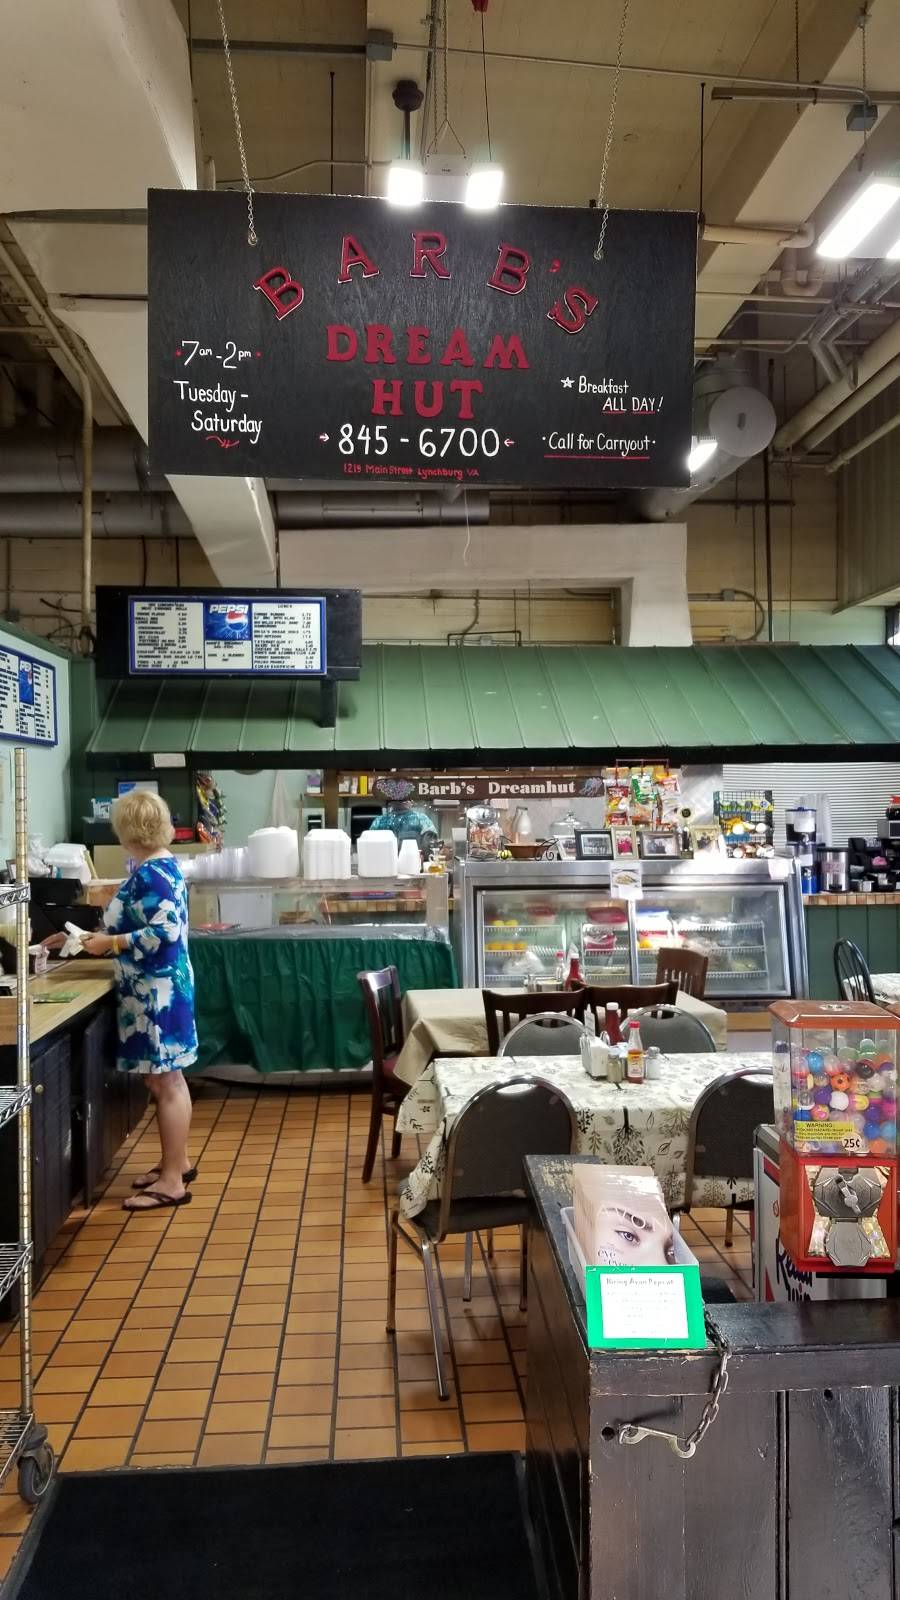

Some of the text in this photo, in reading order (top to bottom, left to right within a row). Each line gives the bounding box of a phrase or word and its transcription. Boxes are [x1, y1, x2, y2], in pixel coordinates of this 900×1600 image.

[253, 232, 599, 334] BARB'S
[325, 324, 531, 370] DREAM
[578, 375, 630, 394] Breakfast
[371, 378, 484, 420] HUT
[602, 396, 664, 412] ALL DAY!
[191, 410, 263, 444] Saturday
[548, 432, 651, 457] Call for Carryout
[417, 467, 464, 480] Lynchburg
[209, 604, 249, 614] PEPSI
[418, 780, 576, 795] Barb's Dreamhut
